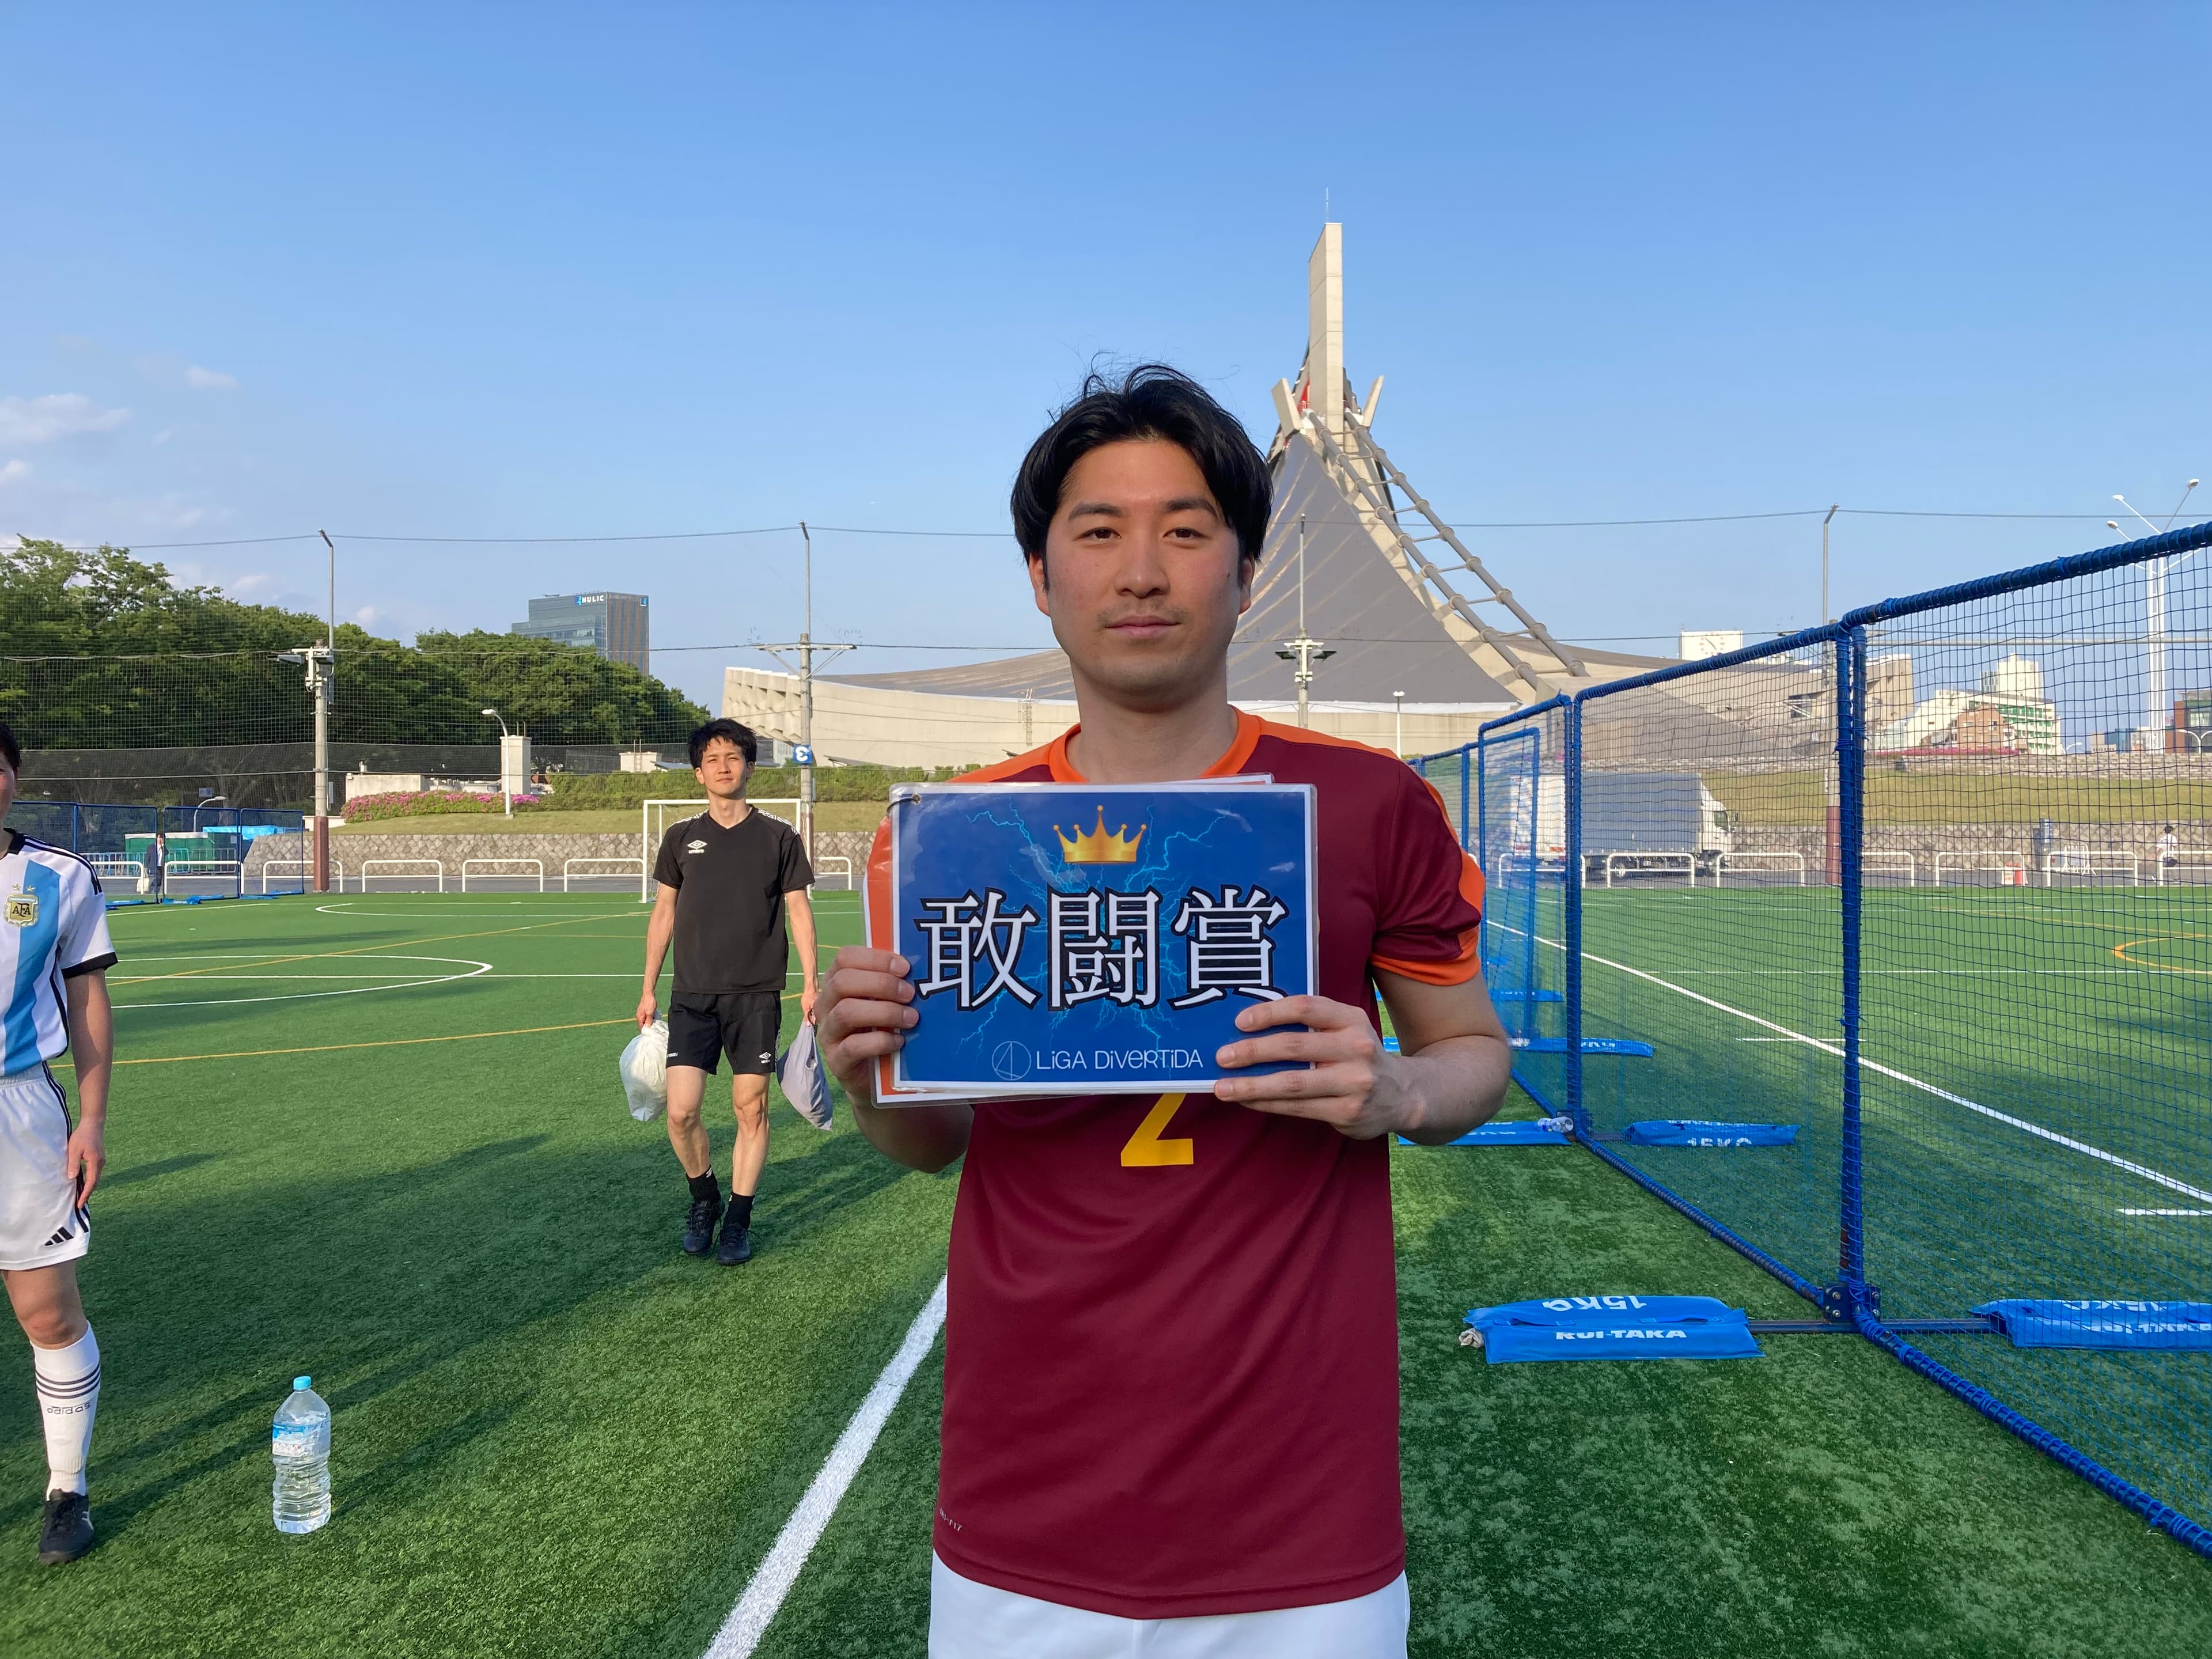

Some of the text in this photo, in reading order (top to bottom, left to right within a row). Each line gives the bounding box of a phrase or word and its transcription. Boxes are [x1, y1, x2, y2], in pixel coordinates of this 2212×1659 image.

[582, 595, 604, 604] HULIC
[12, 902, 32, 917] AFA
[915, 886, 1289, 1010] 敢闘賞
[1556, 1330, 1687, 1340] RUI-TAKA
[47, 1402, 91, 1415] adidas
